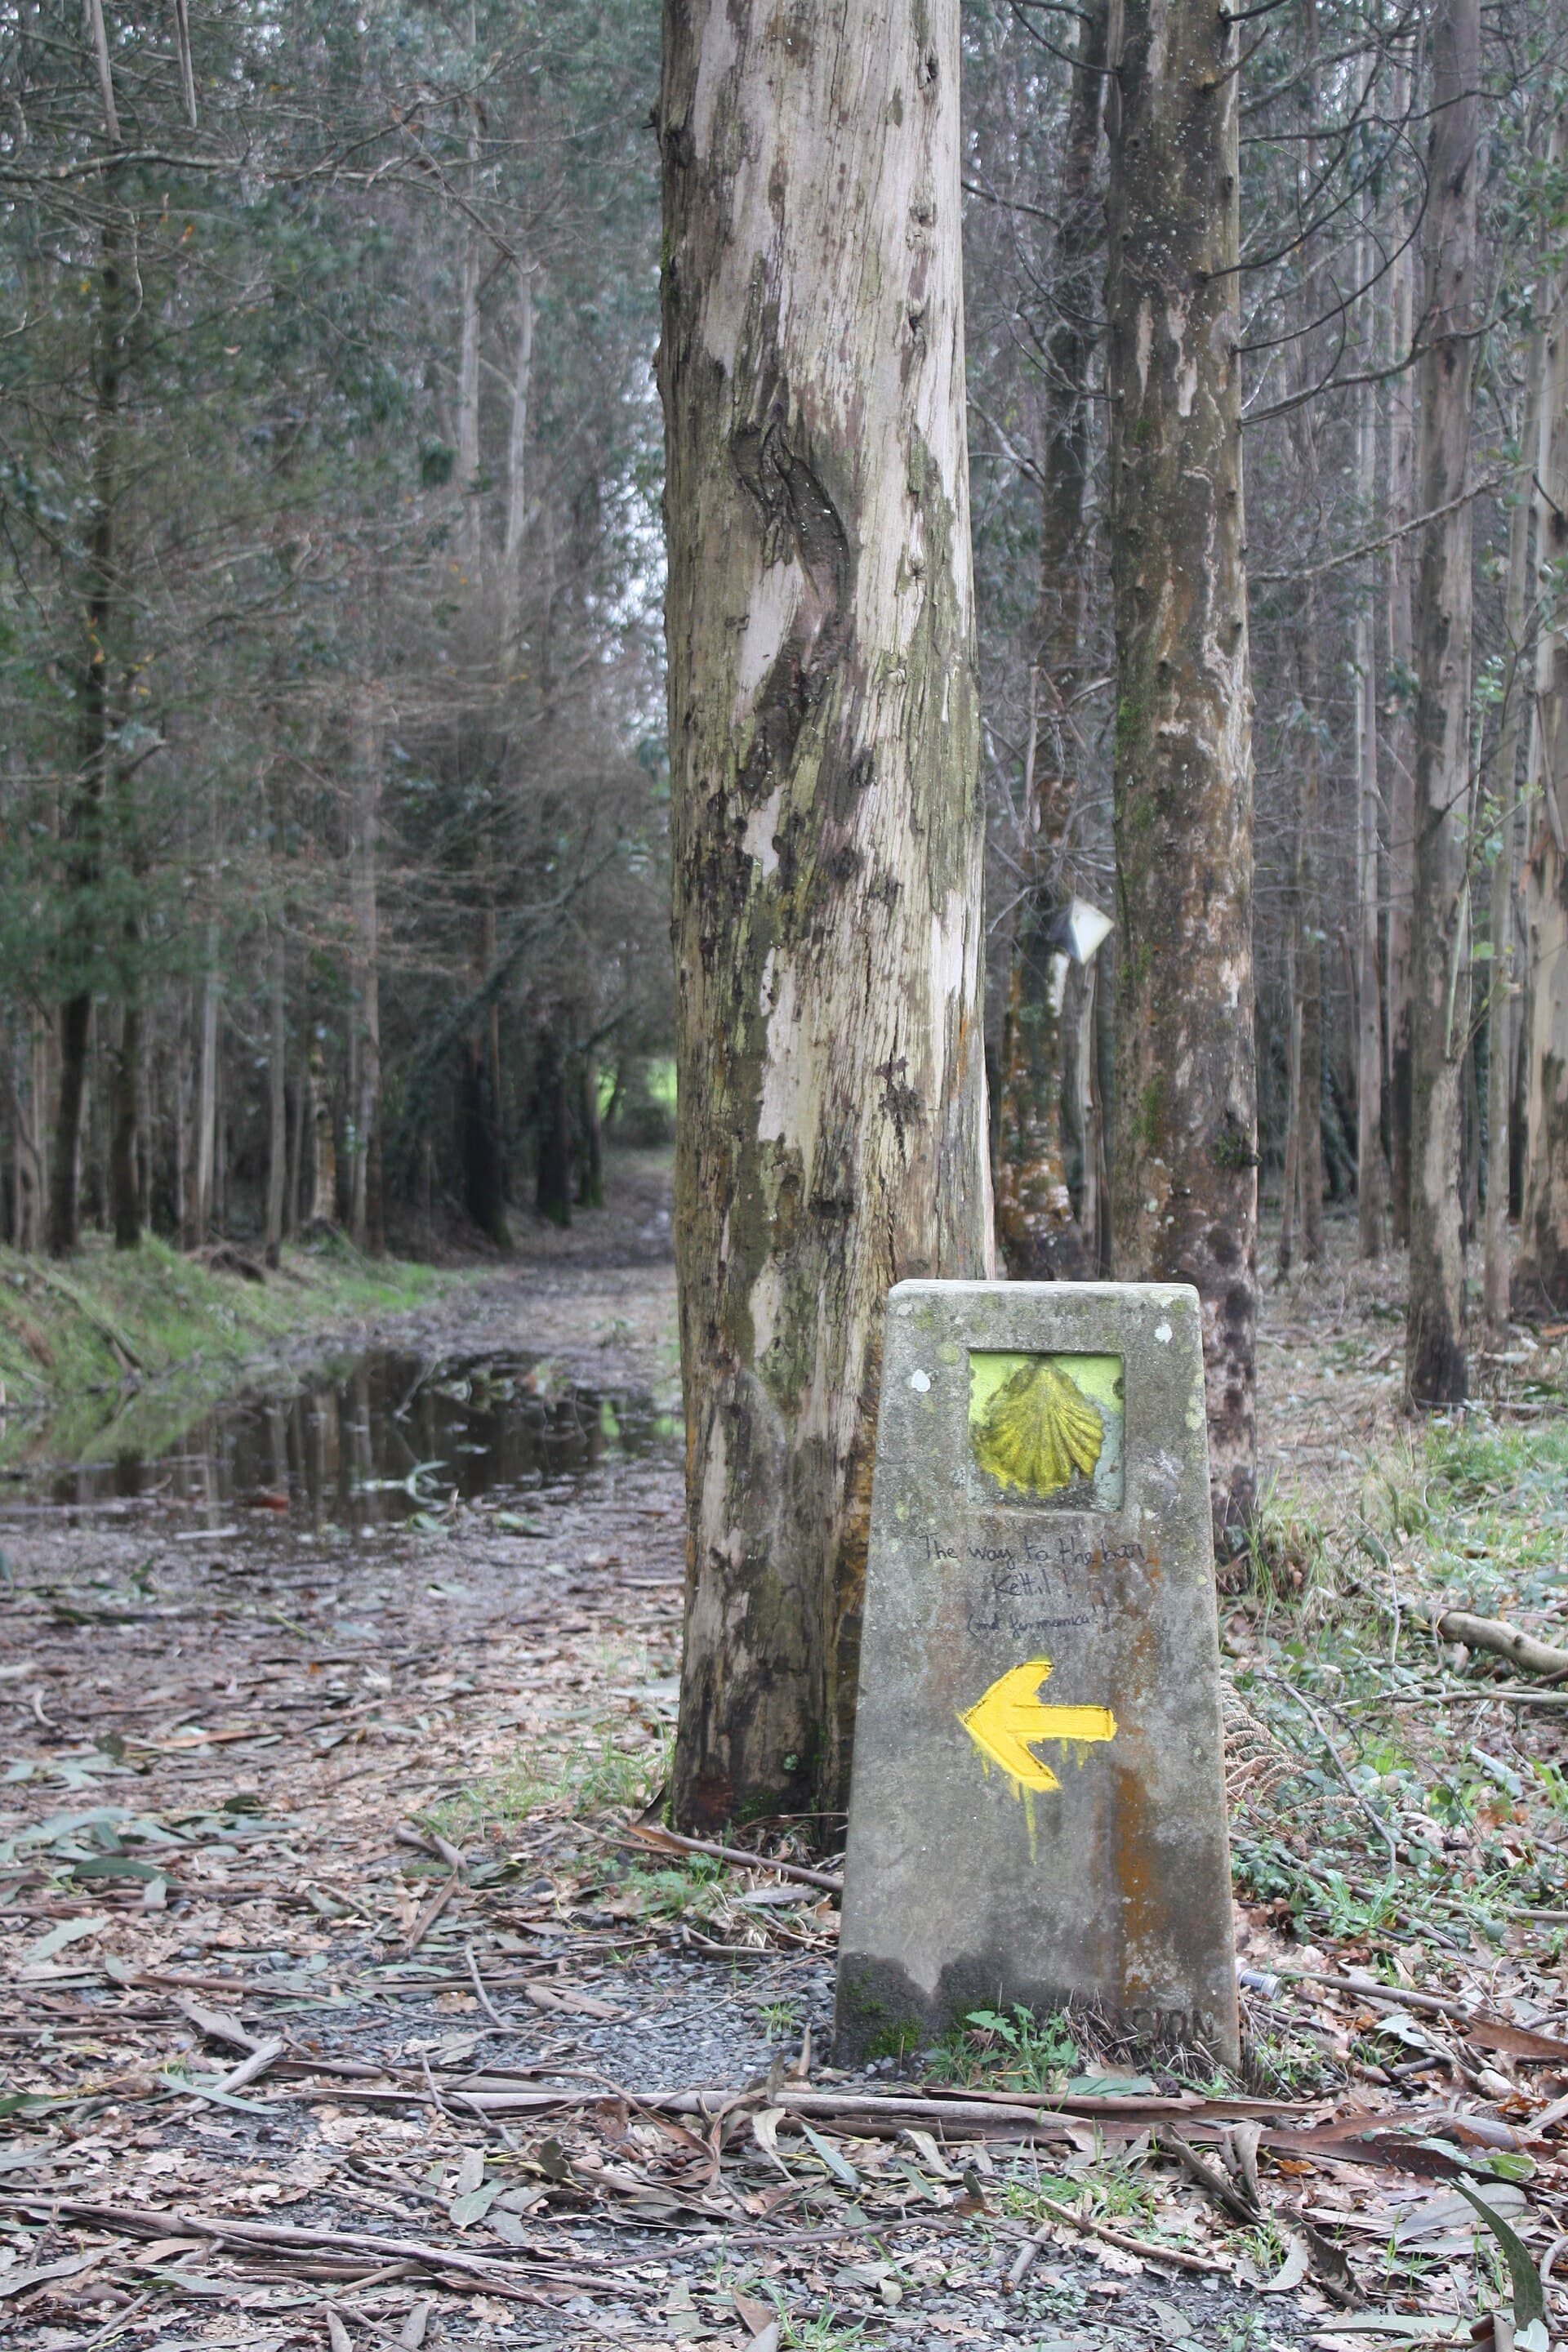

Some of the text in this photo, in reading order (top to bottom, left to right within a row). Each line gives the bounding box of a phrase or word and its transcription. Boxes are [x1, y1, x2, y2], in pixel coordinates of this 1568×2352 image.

[918, 1531, 959, 1560] The
[967, 1543, 1014, 1570] way
[1024, 1535, 1049, 1561] to
[1058, 1535, 1098, 1566] the
